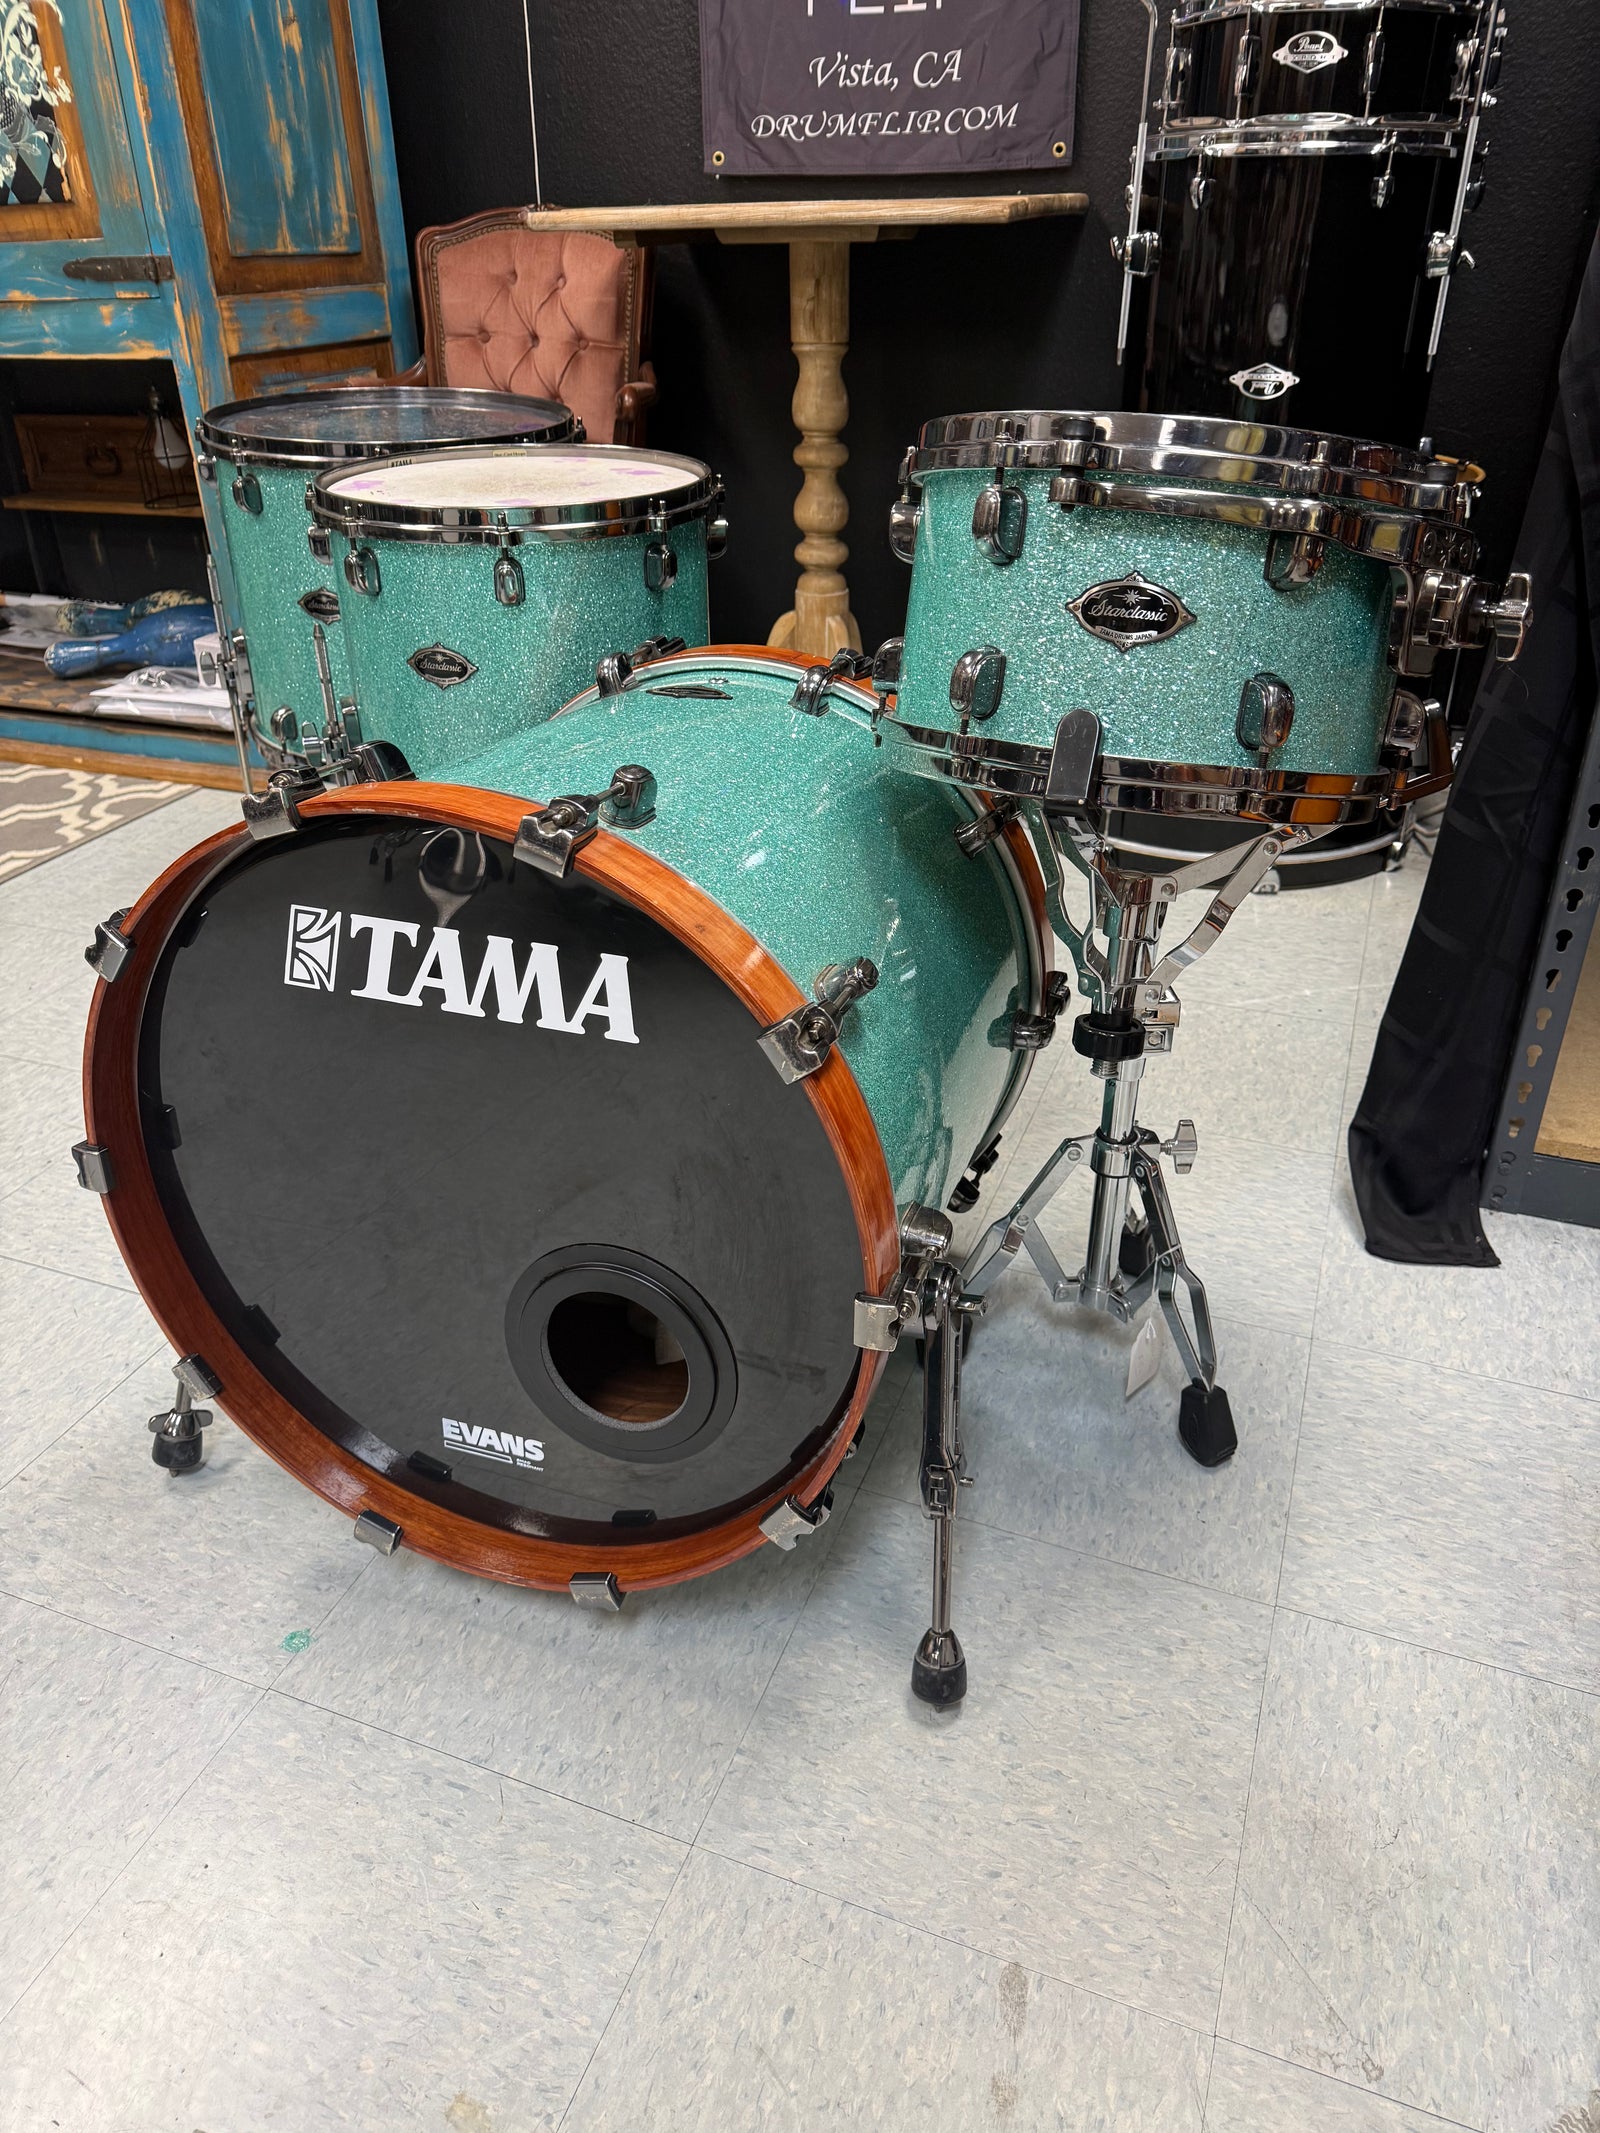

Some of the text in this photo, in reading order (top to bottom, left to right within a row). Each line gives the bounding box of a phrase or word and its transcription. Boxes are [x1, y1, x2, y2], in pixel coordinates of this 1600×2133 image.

[1293, 36, 1326, 52] Pearl
[809, 49, 963, 92] Vista, CA
[751, 103, 1019, 142] DRUMFLIP.COM
[1087, 600, 1168, 622] Starclassic
[1099, 627, 1153, 641] TAMA DRUMS JAPAN
[419, 658, 462, 673] Starclassic
[350, 913, 640, 1044] TAMA
[442, 1417, 545, 1462] EVANS
